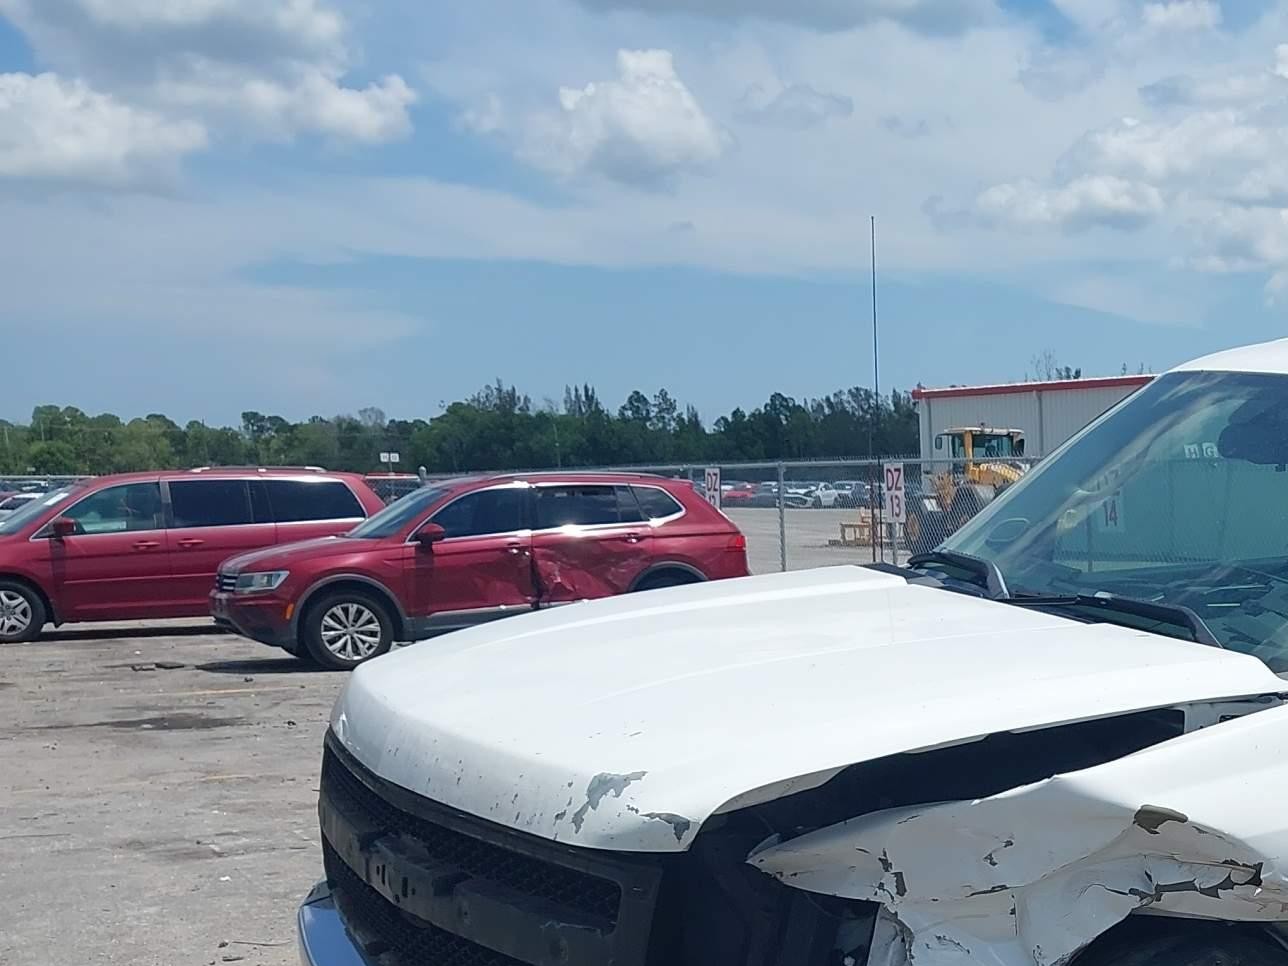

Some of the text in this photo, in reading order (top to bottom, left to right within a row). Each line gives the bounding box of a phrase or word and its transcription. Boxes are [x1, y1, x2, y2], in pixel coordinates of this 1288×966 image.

[707, 472, 719, 492] DZ
[886, 468, 902, 491] DZ
[890, 494, 902, 518] 13
[1102, 499, 1118, 527] 14
